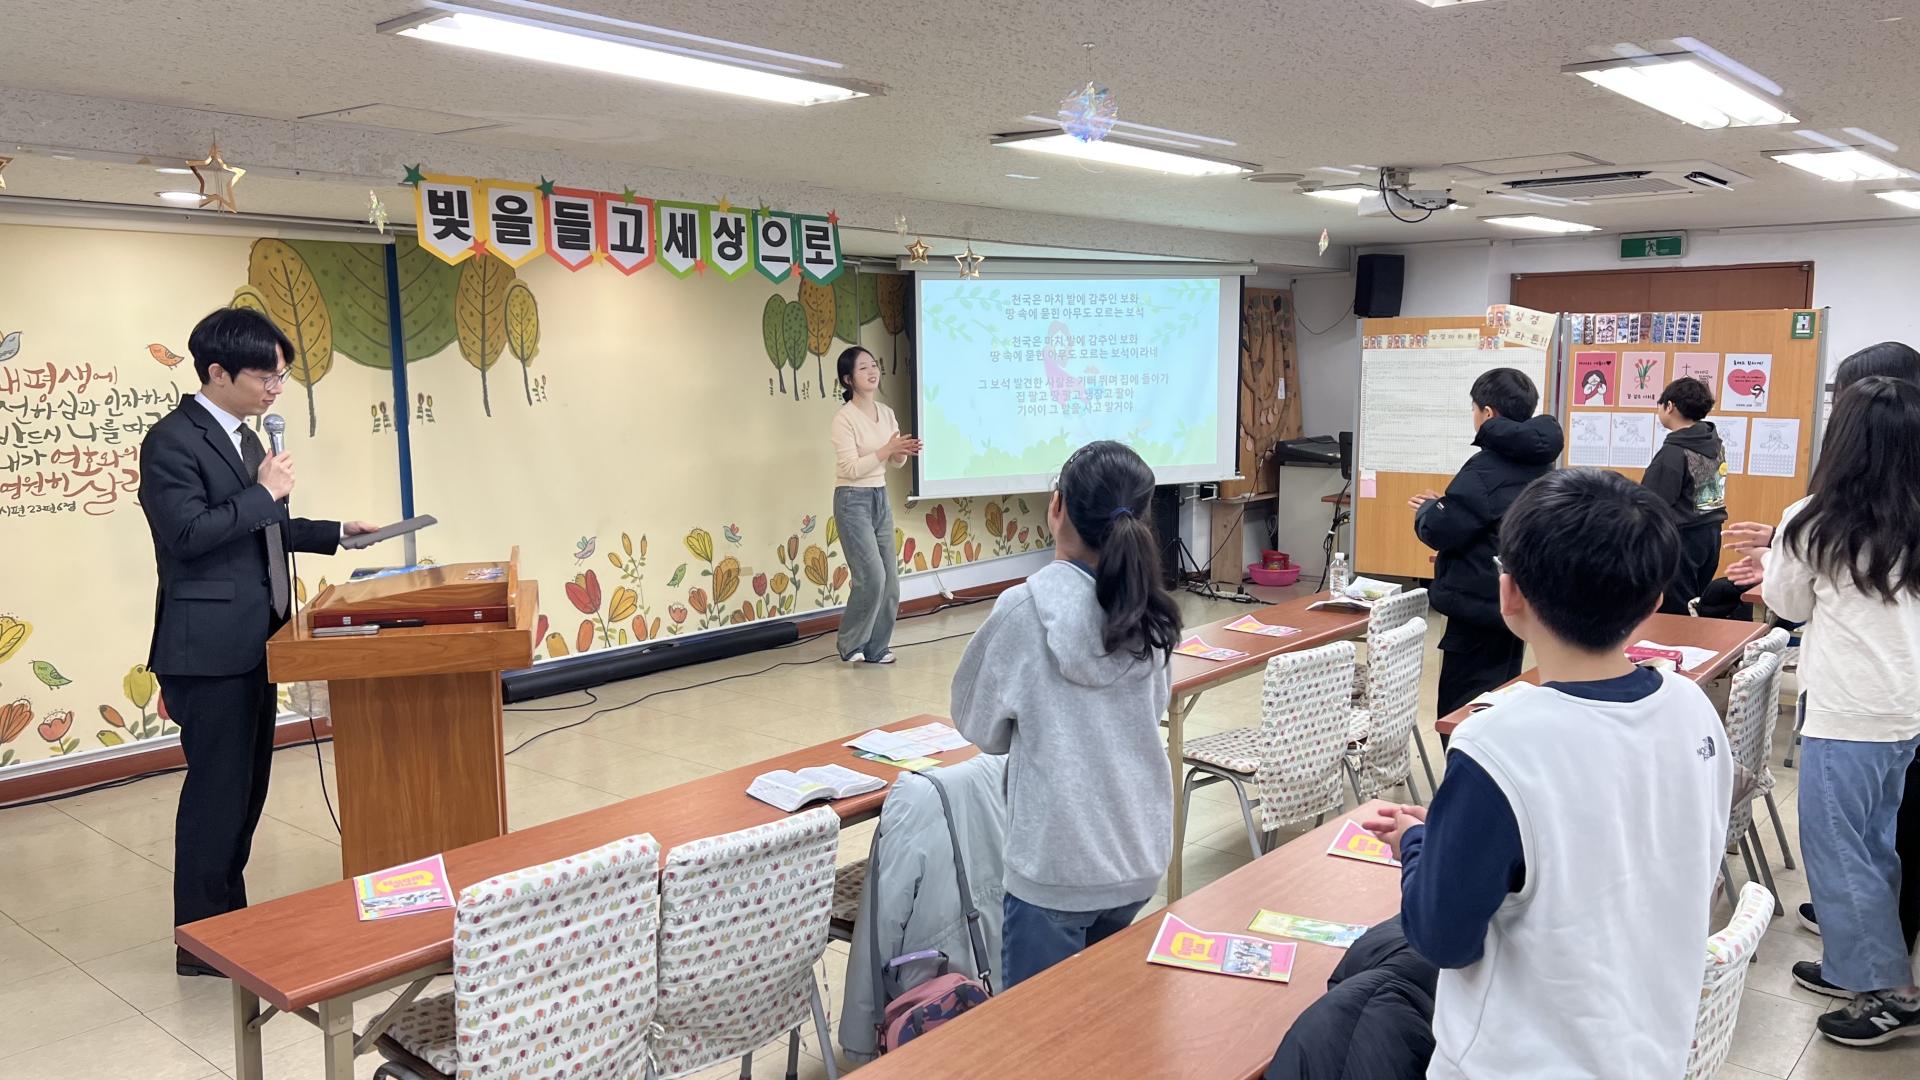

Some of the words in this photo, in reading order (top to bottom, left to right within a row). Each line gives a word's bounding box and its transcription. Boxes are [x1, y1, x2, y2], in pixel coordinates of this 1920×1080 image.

[1045, 293, 1064, 306] 마치
[1062, 307, 1092, 319] 아무도
[1094, 307, 1124, 318] 모르는
[1125, 307, 1144, 319] 보석
[104, 381, 181, 417] 인자하심
[67, 419, 122, 444] 나를
